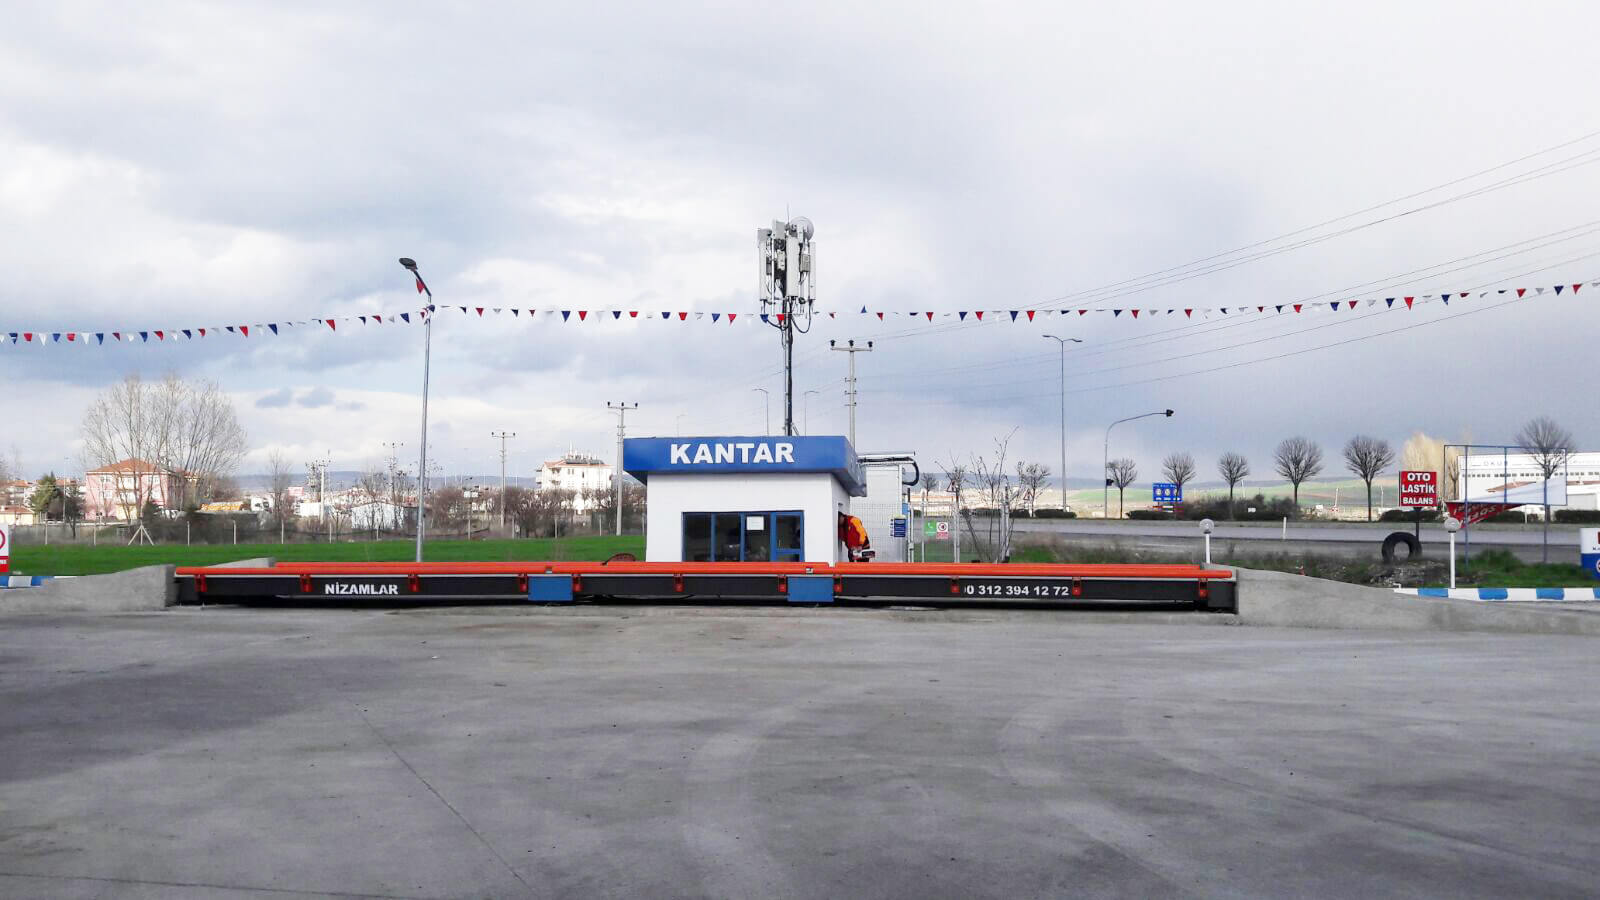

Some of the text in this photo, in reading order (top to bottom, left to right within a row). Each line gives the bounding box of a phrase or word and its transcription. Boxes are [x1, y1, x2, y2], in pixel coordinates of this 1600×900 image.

[670, 443, 795, 464] KANTAR
[1407, 472, 1431, 481] OTO
[1401, 483, 1435, 493] LASTİK
[325, 581, 399, 595] NİZAMLAR
[978, 585, 1002, 595] 312
[1005, 585, 1030, 595] 394
[1033, 585, 1049, 596] 12
[1053, 586, 1069, 596] 72
